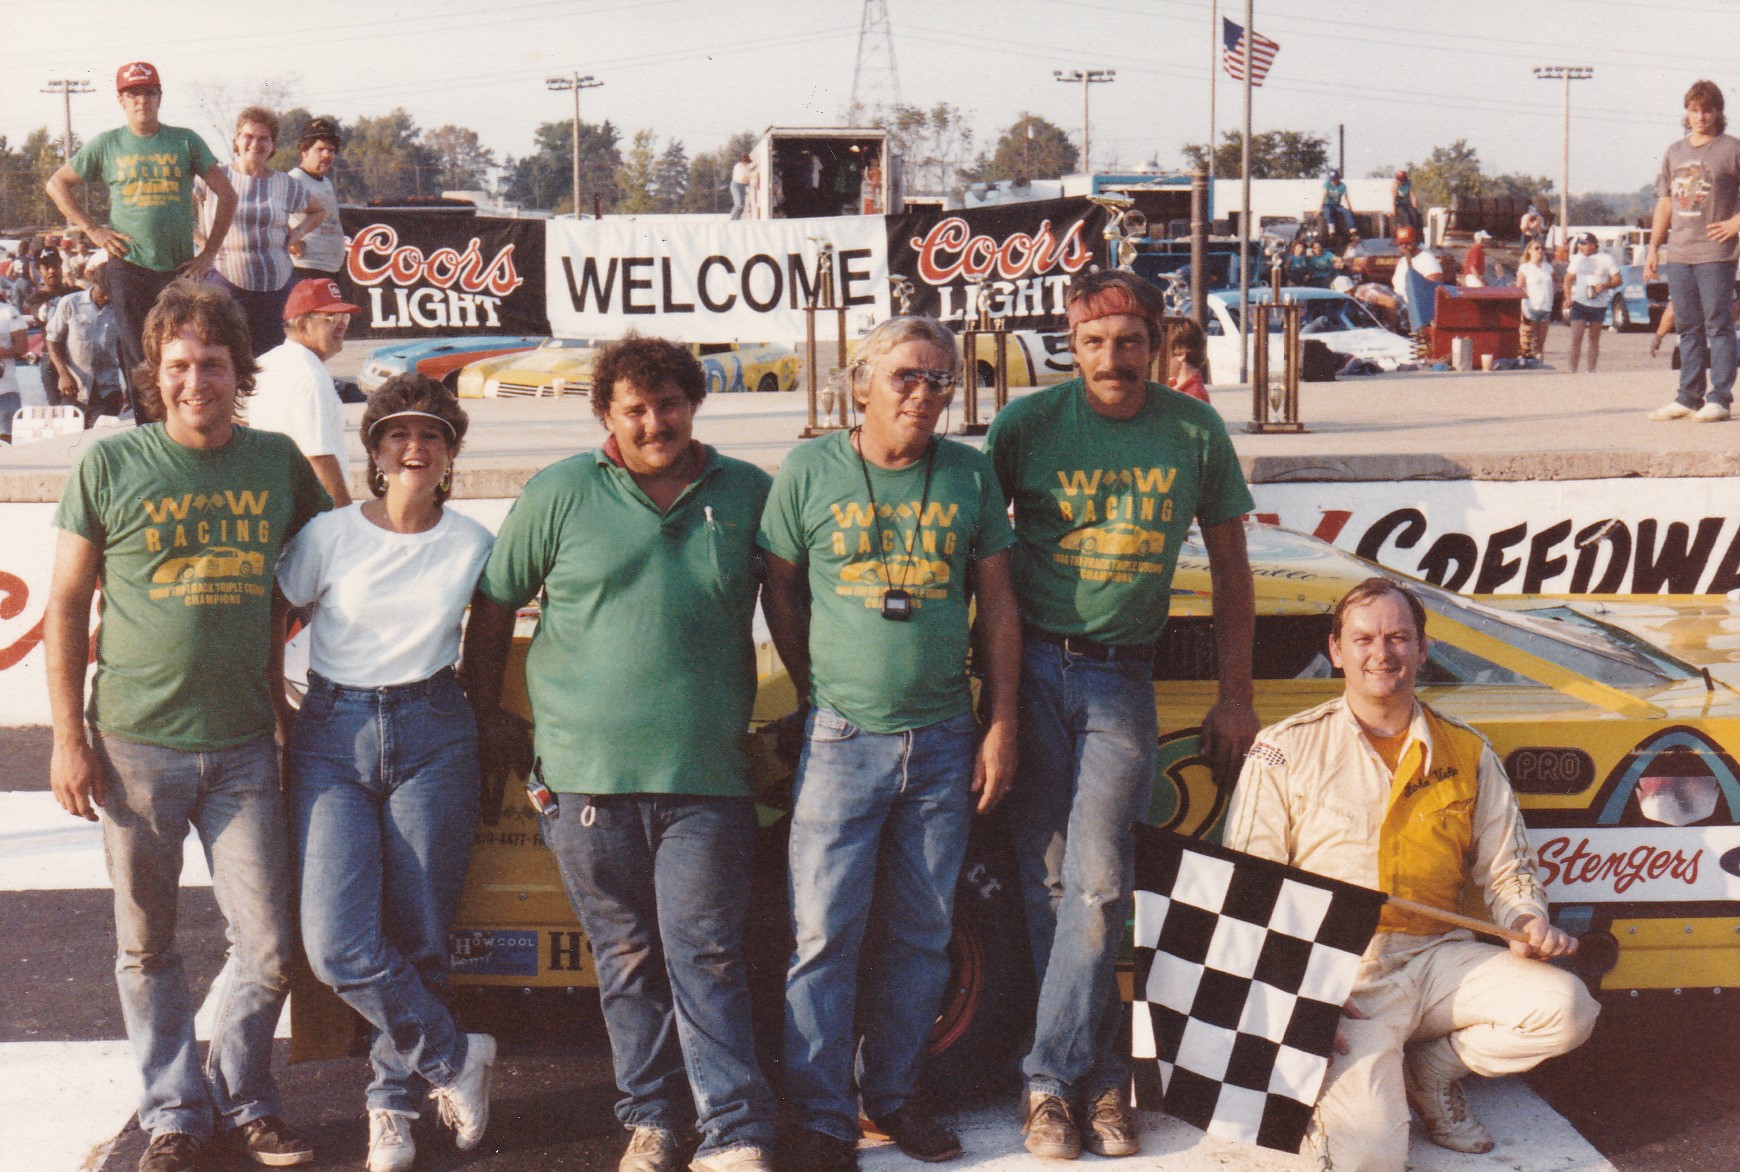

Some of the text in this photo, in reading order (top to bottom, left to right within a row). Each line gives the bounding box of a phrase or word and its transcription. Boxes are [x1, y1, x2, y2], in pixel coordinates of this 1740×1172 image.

[345, 223, 523, 296] Coors
[910, 217, 1093, 285] Coors
[562, 248, 876, 314] WELCOME
[938, 275, 1071, 322] LIGHT
[368, 287, 501, 328] LIGHT
[1060, 496, 1173, 522] RACING
[145, 519, 269, 553] RACING
[832, 529, 957, 555] RACING
[1516, 751, 1580, 781] PRO
[1537, 836, 1703, 894] Stengers
